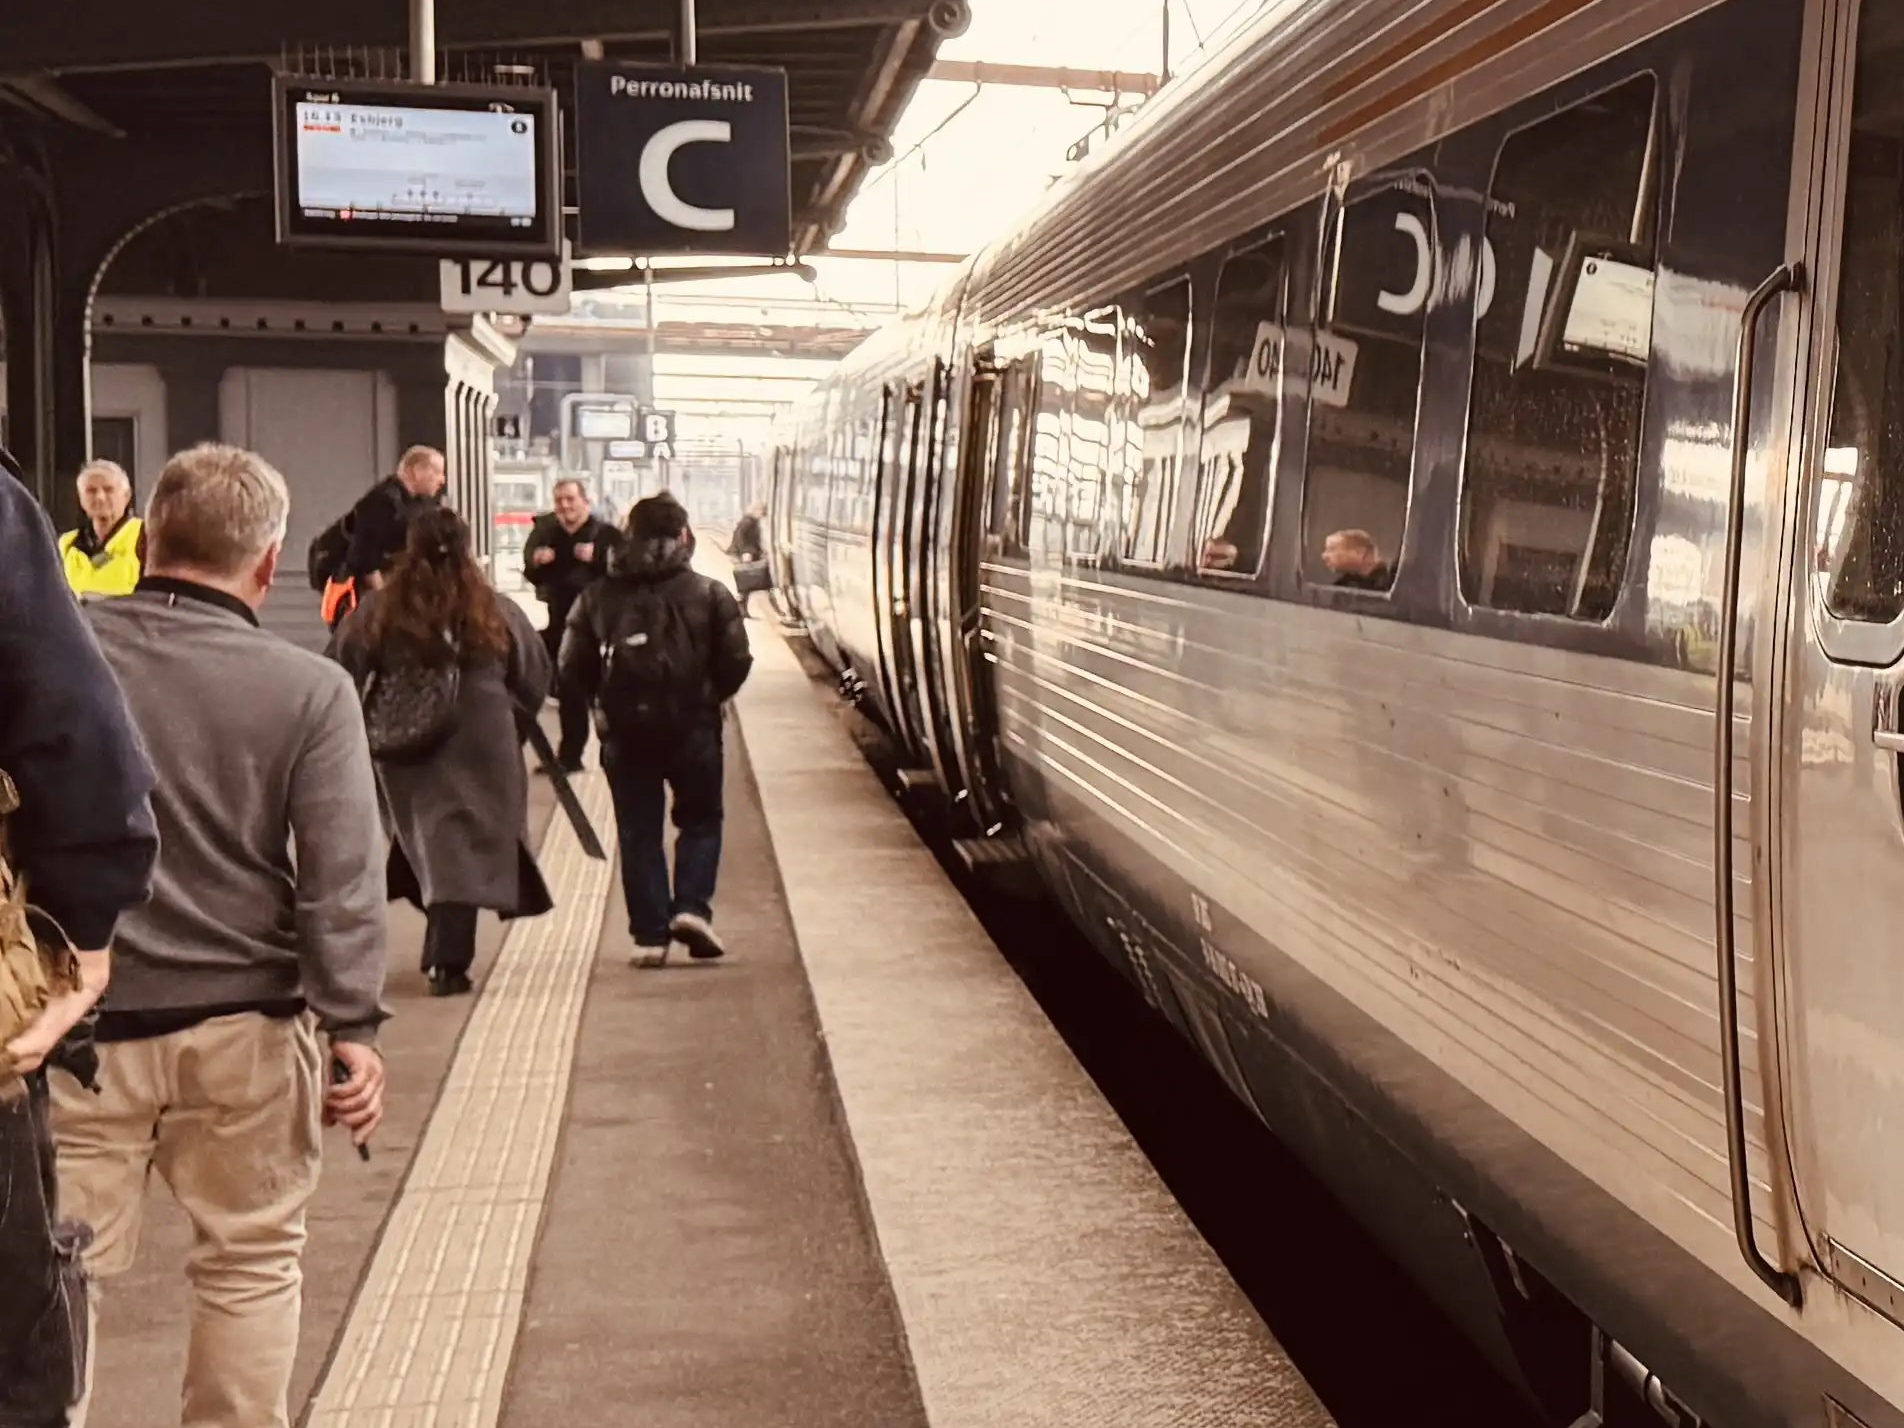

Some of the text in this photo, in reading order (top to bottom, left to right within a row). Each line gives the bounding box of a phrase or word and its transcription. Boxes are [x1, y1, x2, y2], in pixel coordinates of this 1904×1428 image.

[610, 76, 753, 102] Perronafsnit
[638, 120, 735, 231] C
[457, 260, 561, 297] 140
